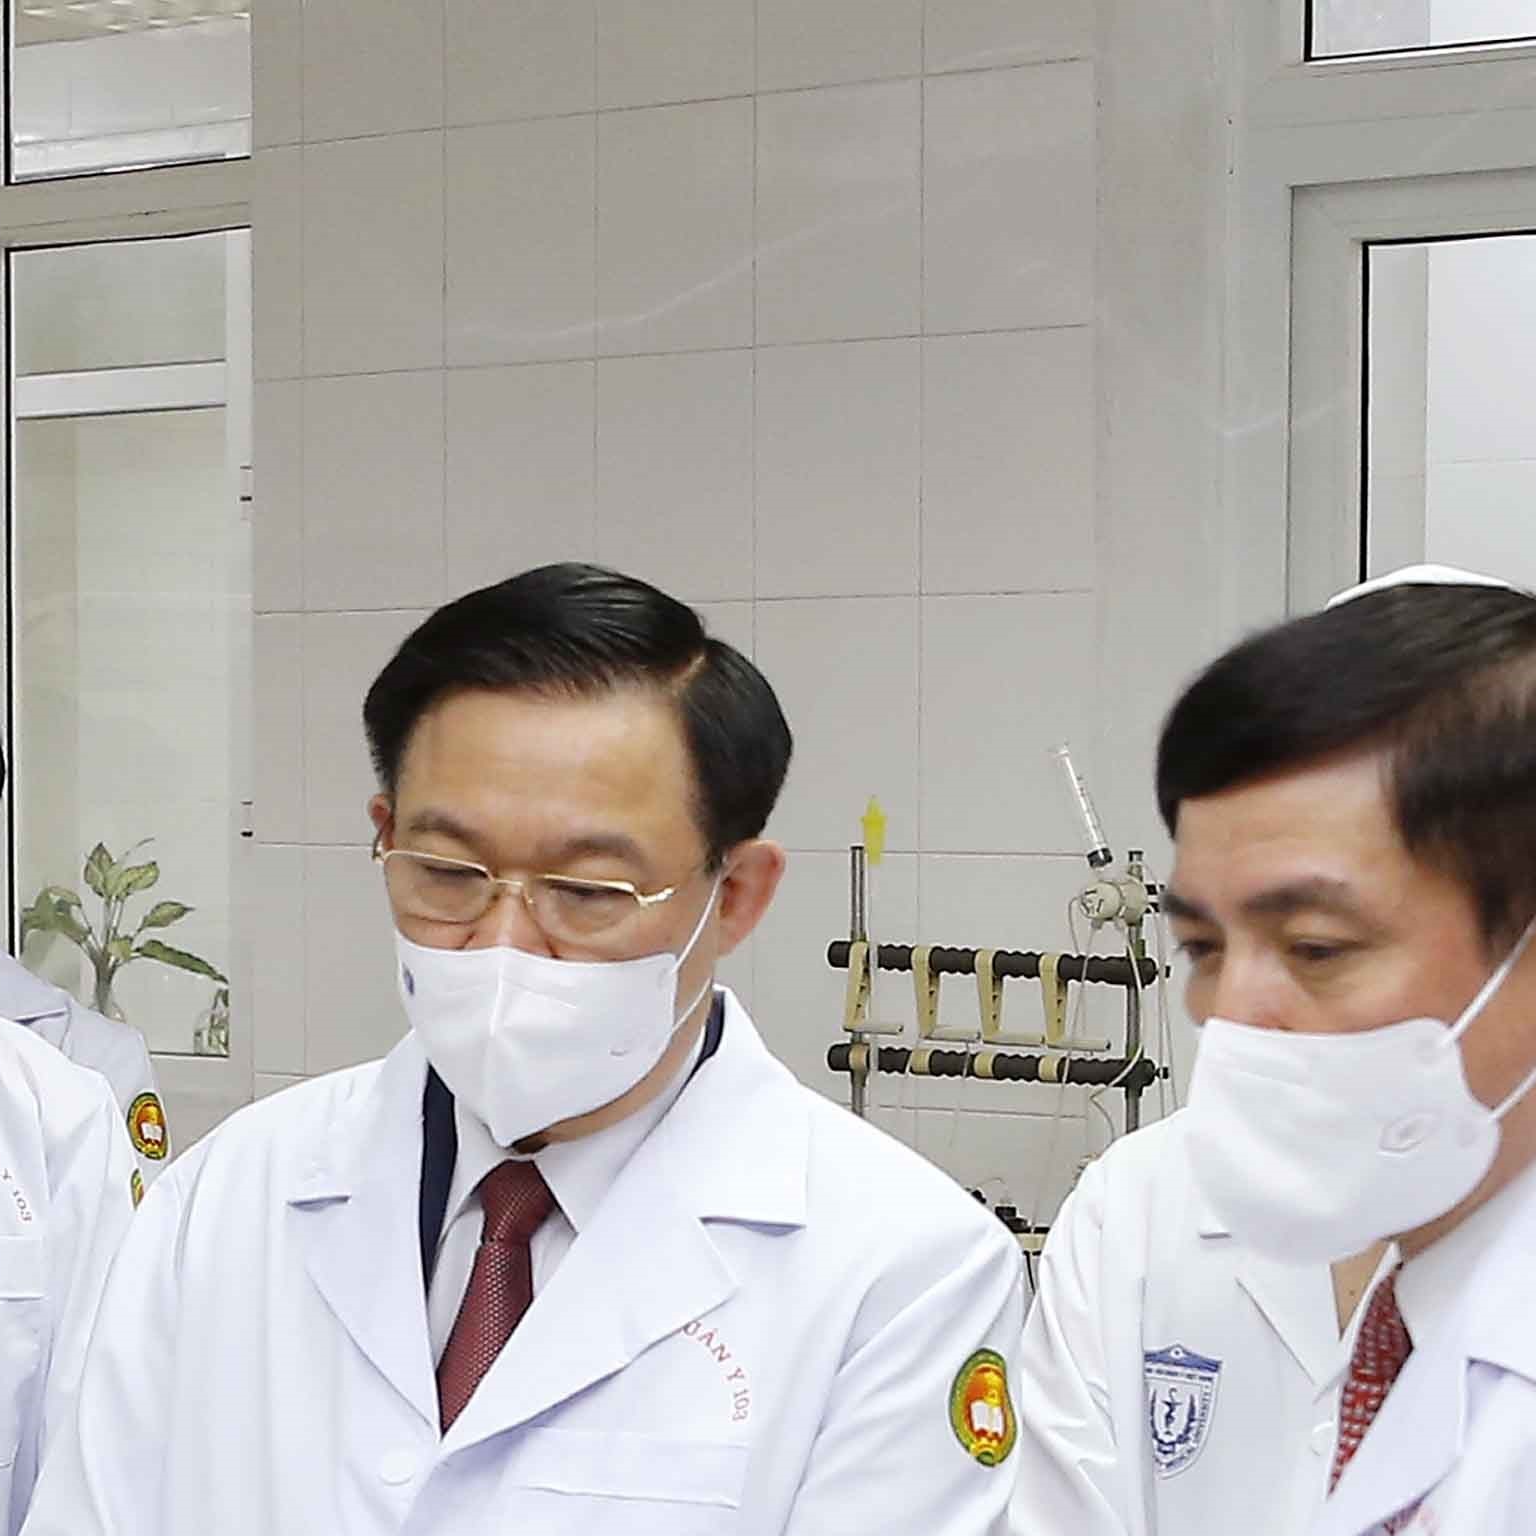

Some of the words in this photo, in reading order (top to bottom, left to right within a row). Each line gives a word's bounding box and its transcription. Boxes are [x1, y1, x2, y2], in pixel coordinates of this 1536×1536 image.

[682, 1320, 731, 1362] UÂN
[727, 1367, 745, 1381] Y
[732, 1388, 749, 1421] 103
